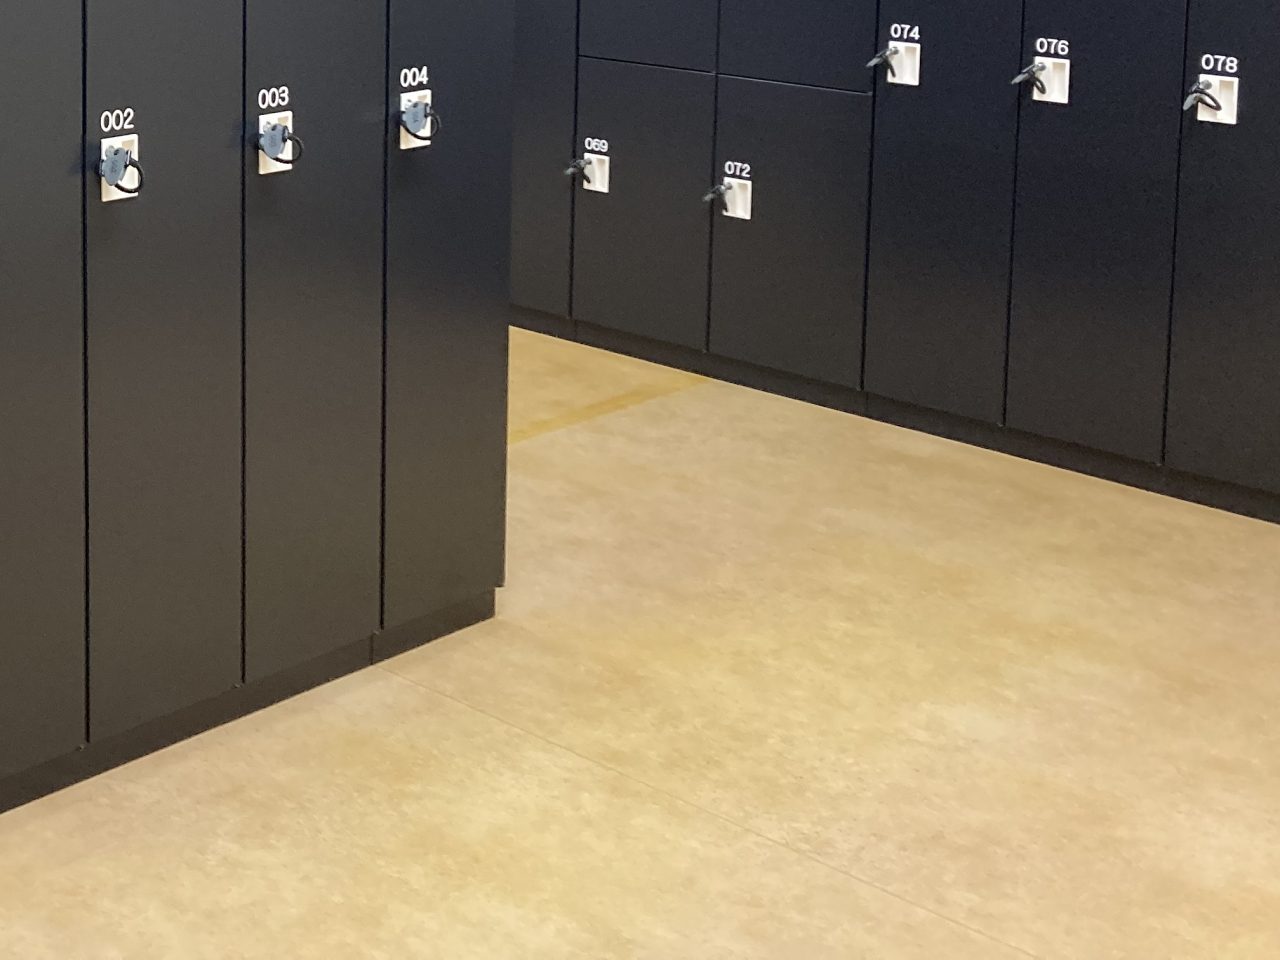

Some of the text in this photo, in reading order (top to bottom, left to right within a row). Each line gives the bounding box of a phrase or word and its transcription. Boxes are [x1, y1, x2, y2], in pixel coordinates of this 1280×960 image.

[891, 24, 920, 40] 074
[1036, 38, 1068, 55] 076
[1202, 54, 1237, 73] 078
[400, 66, 428, 87] 004
[258, 86, 289, 109] 003
[101, 108, 134, 132] 002
[585, 138, 608, 152] 069
[725, 161, 750, 176] 072
